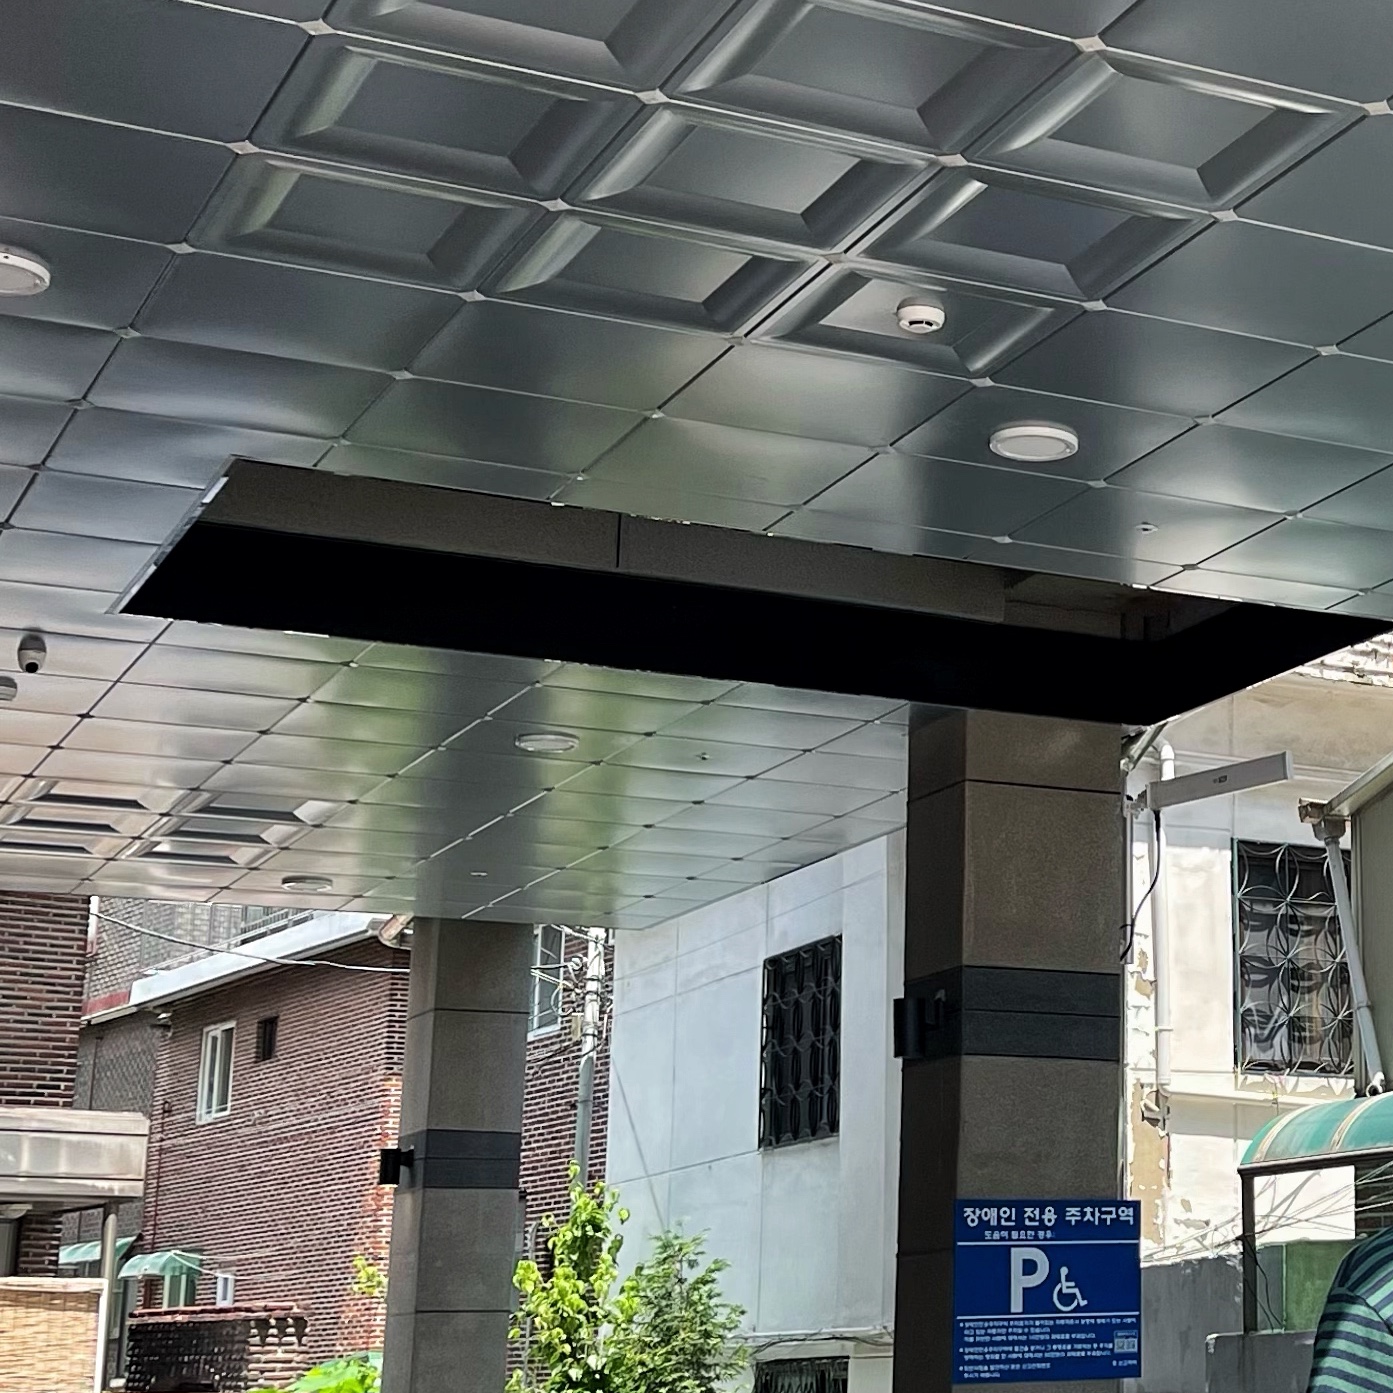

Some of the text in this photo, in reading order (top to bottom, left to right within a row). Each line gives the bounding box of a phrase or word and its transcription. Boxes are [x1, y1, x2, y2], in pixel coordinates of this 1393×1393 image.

[963, 1206, 1134, 1227] 장애인 전용 주차구역
[1010, 1247, 1050, 1313] P
